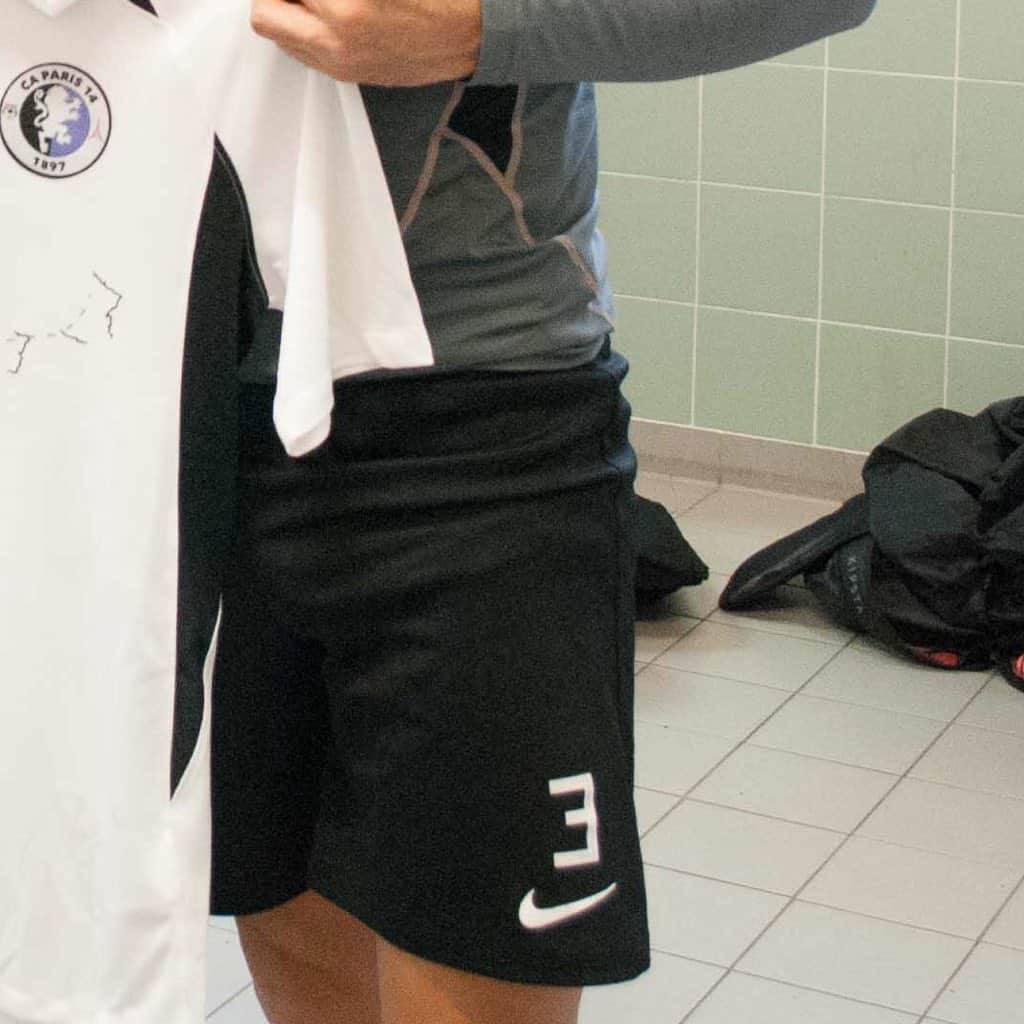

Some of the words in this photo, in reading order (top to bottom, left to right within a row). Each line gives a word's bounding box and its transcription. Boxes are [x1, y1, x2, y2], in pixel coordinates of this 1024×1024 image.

[20, 74, 39, 91] CA
[41, 69, 84, 88] PARIS
[84, 86, 98, 104] 14
[33, 156, 66, 172] 1897
[548, 772, 600, 869] 3
